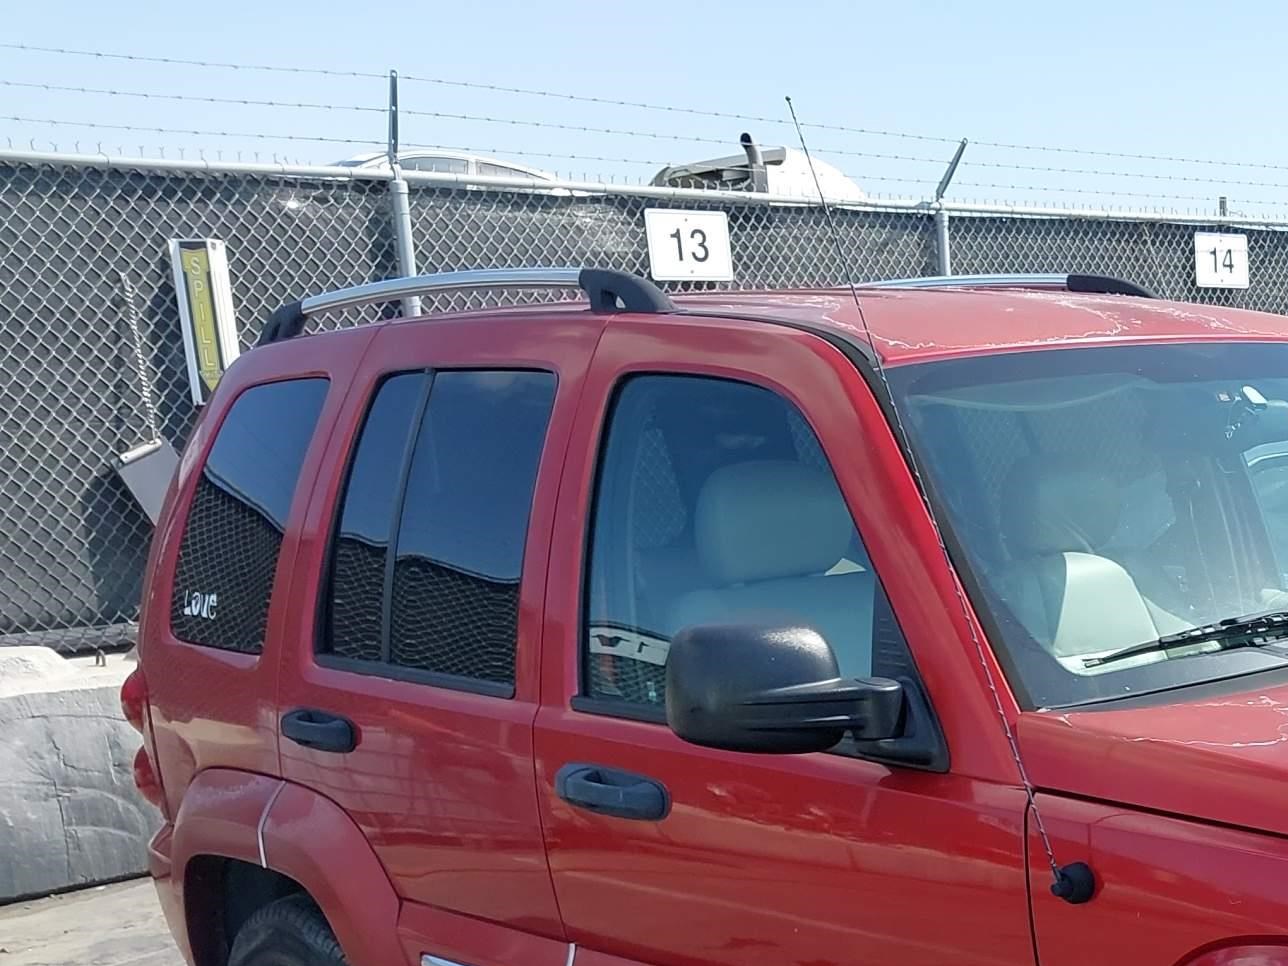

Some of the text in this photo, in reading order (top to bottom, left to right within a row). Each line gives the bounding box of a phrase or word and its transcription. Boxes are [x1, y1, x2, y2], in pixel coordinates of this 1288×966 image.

[670, 228, 709, 263] 13
[1209, 247, 1235, 274] 14
[189, 257, 215, 366] SPILL
